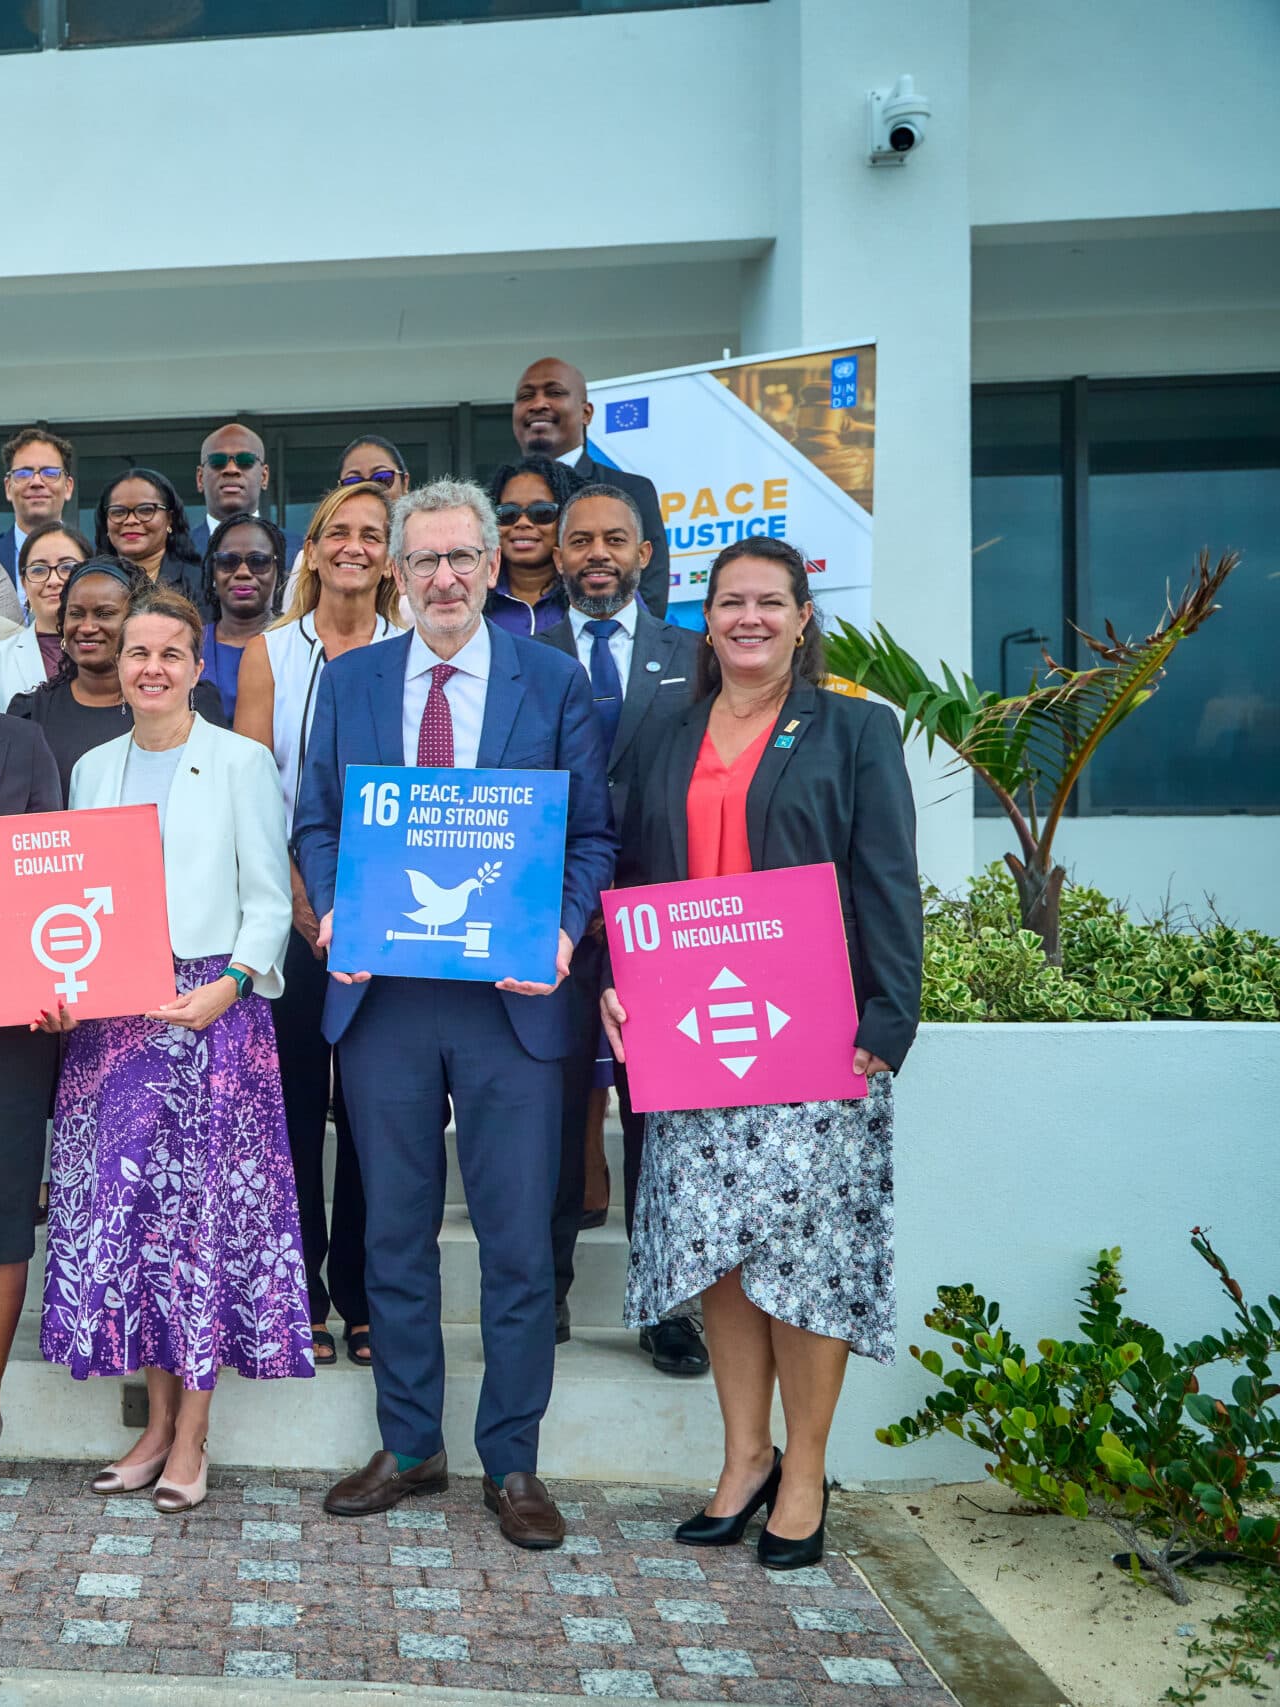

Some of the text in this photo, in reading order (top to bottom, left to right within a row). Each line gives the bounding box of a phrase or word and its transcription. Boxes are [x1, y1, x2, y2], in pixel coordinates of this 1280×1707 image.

[660, 478, 788, 523] PACE
[360, 782, 400, 826] 16
[410, 784, 533, 805] PEACE, JUSTICE
[407, 807, 508, 827] AND STRONG
[12, 830, 71, 851] GENDER
[406, 828, 515, 850] INSTITUTIONS
[14, 853, 85, 876] EQUALITY
[668, 896, 744, 922] REDUCED
[615, 903, 661, 953] 10
[672, 919, 784, 950] INEQUALITIES
